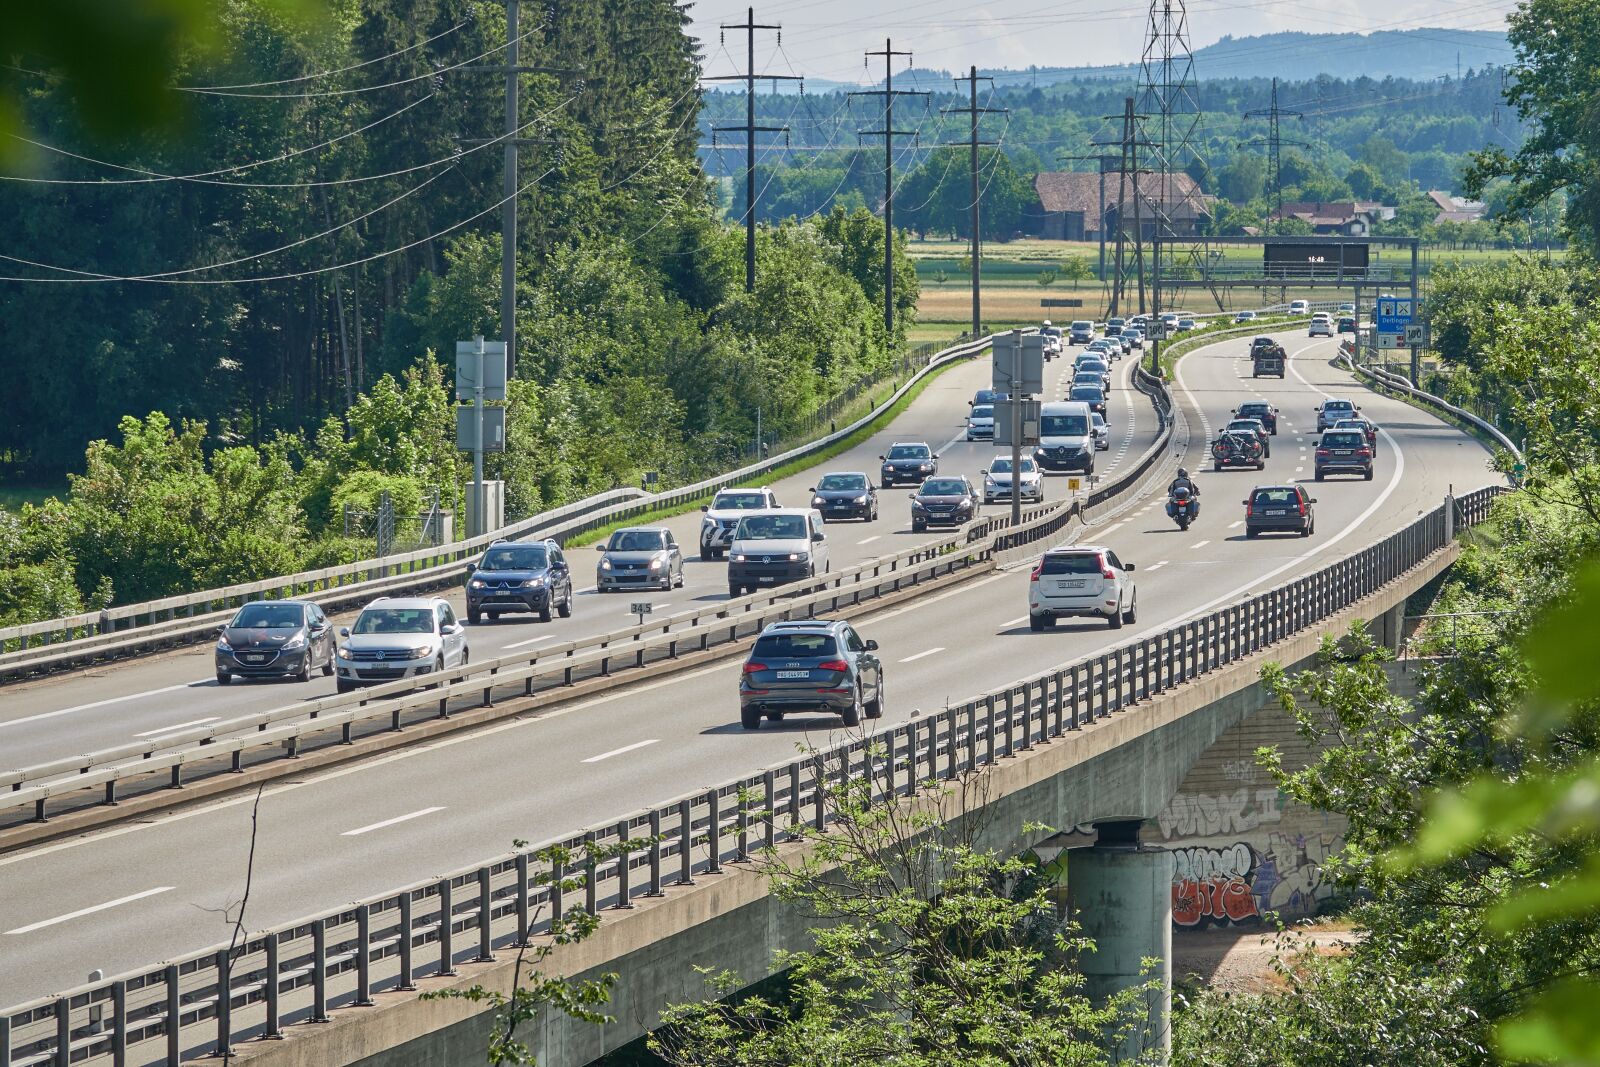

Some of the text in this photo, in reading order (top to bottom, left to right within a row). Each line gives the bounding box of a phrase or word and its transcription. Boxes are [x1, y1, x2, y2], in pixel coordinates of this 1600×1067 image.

[1149, 326, 1163, 335] 100
[1407, 328, 1422, 339] 100
[632, 603, 651, 613] 34.5
